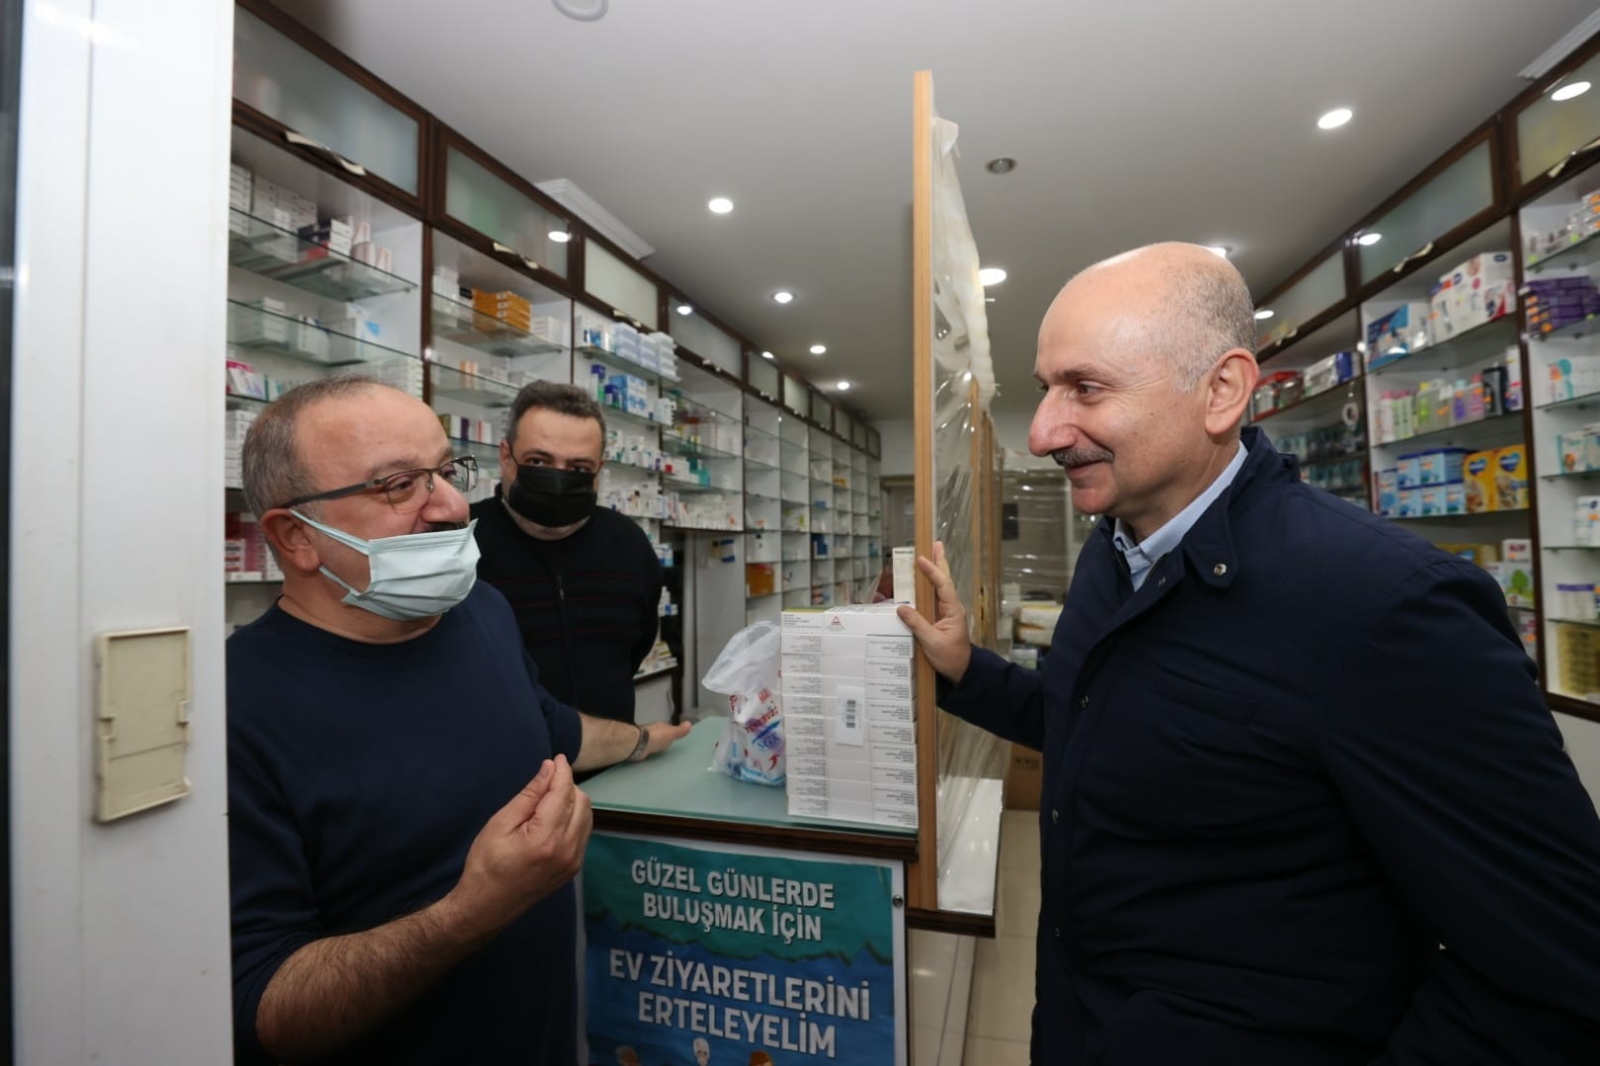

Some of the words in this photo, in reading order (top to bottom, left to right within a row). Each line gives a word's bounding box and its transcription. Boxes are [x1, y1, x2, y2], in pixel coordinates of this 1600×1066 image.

[631, 856, 701, 893] GÜZEL
[707, 868, 835, 909] GÜNLERDE
[643, 892, 765, 933] BULUŞMAK
[772, 905, 822, 944] İÇİN
[609, 948, 644, 981] EV
[650, 951, 870, 1021] ZİYARETLERİNİ
[638, 992, 836, 1058] ERTELEYELİM
